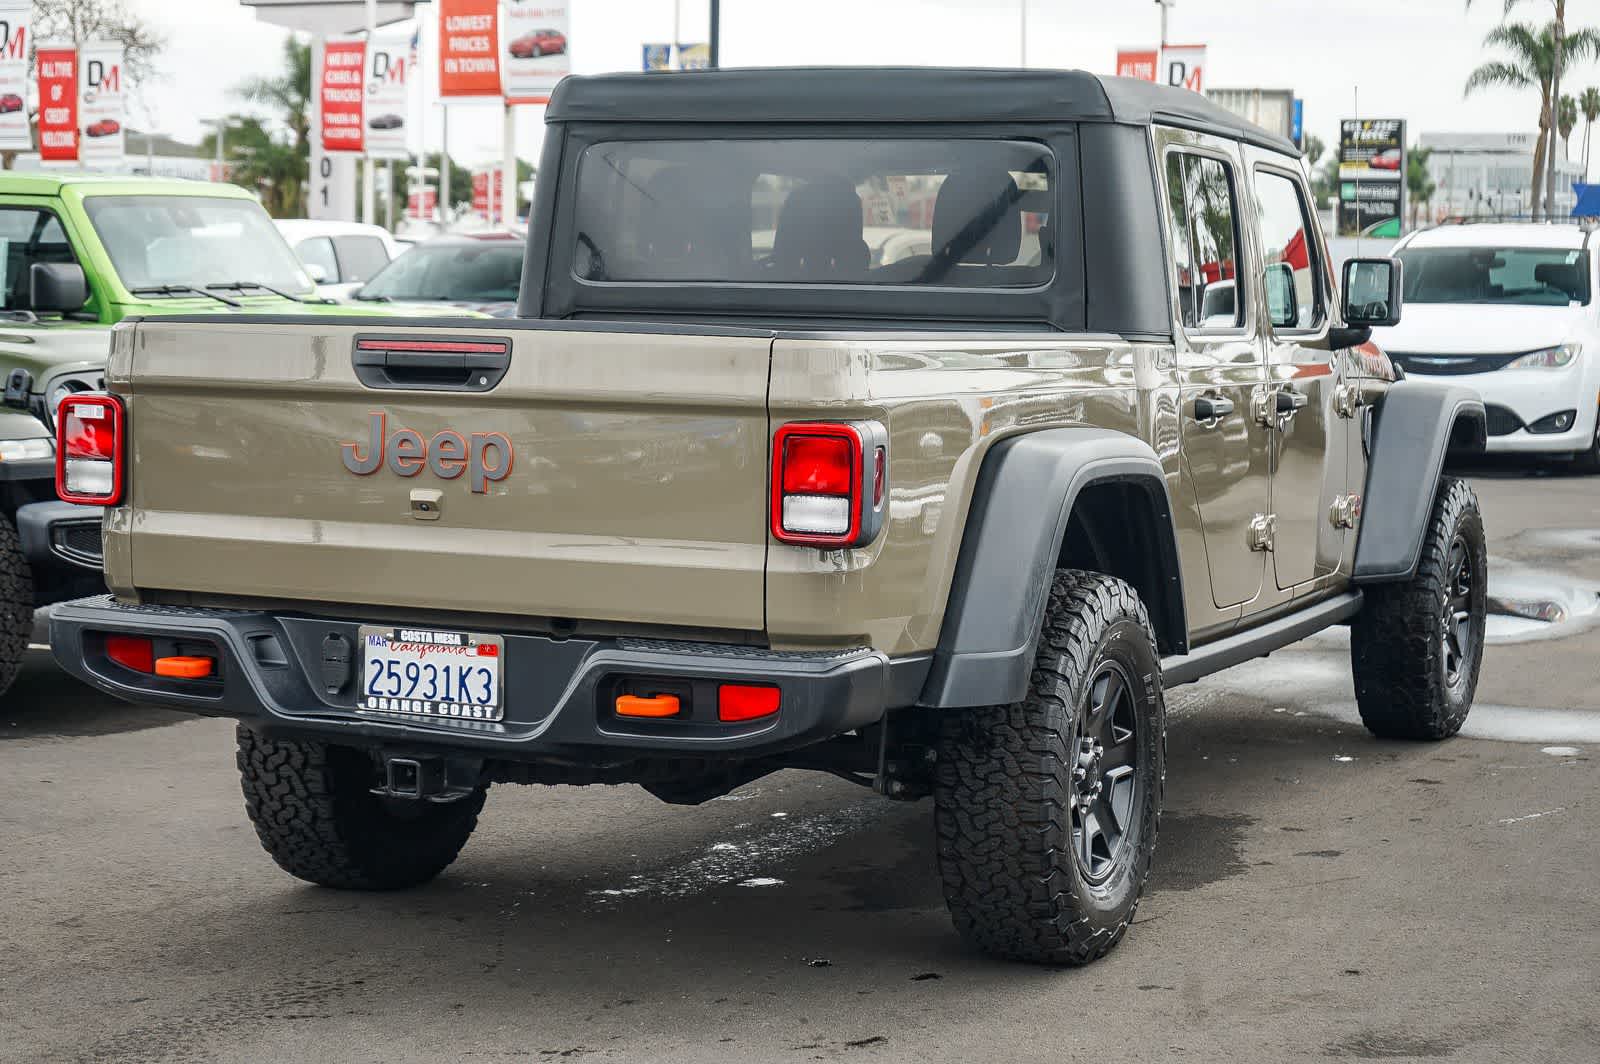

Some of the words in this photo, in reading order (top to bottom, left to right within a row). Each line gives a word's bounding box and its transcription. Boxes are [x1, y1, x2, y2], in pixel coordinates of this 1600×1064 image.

[446, 15, 492, 32] LOWEST
[449, 36, 490, 52] PRICES
[444, 58, 457, 73] IN
[458, 57, 496, 73] TOWN
[341, 410, 514, 494] Jeep
[368, 635, 387, 647] MAR
[400, 630, 433, 643] COSTA
[434, 632, 461, 645] MESA
[390, 641, 475, 659] California
[368, 658, 492, 705] 25931K3
[367, 696, 432, 713] ORANGE
[438, 703, 494, 719] COAST
